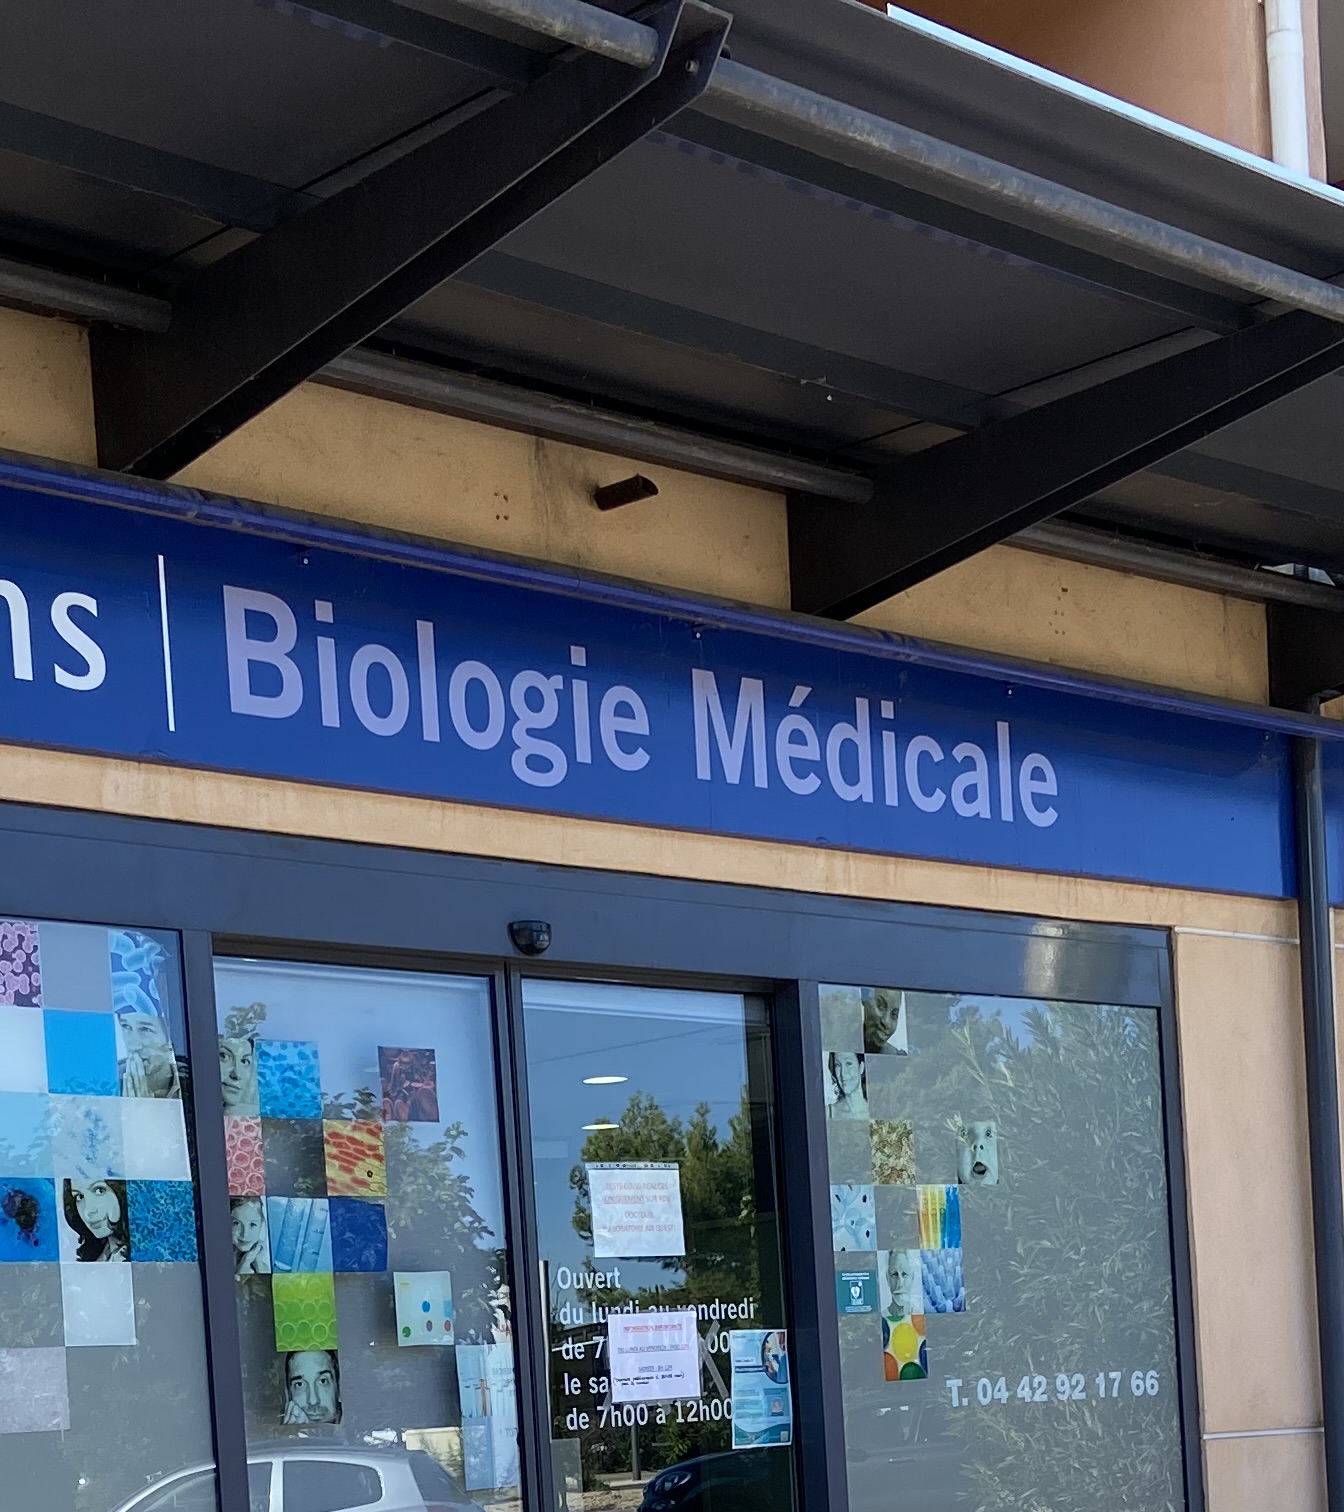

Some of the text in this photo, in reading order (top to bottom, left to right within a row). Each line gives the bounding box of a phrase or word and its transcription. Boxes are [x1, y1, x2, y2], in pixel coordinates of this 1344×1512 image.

[222, 585, 1058, 828] Biologie Médicale
[557, 1266, 621, 1290] Ouvert
[560, 1301, 578, 1324] du
[562, 1336, 585, 1360] de
[564, 1372, 583, 1396] le
[946, 1370, 1159, 1408] T. 04 42 92 17 66
[566, 1407, 589, 1431] de
[597, 1404, 649, 1429] 7h00
[656, 1402, 666, 1425] à
[676, 1398, 733, 1423] 12h00
